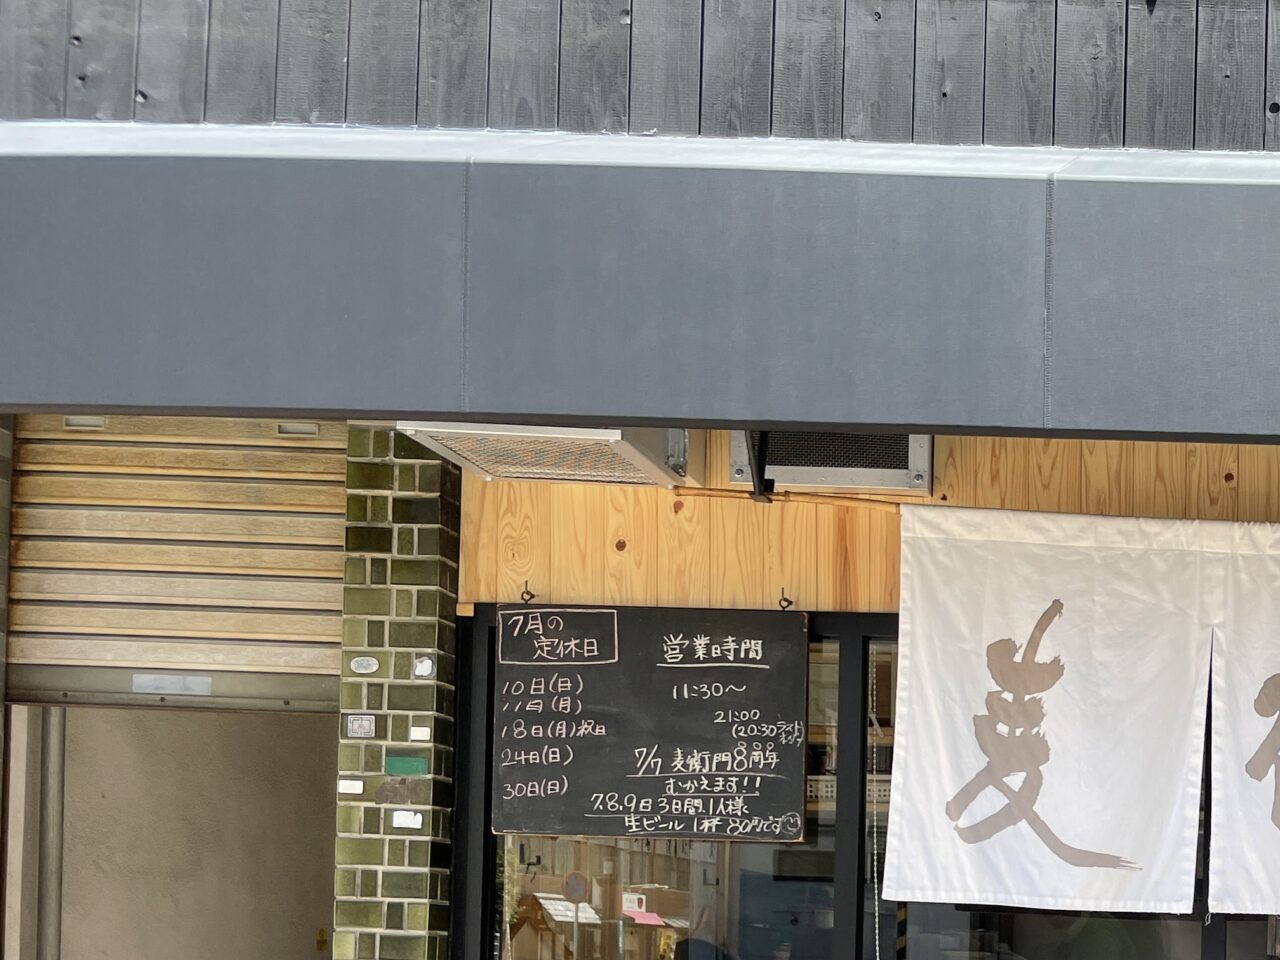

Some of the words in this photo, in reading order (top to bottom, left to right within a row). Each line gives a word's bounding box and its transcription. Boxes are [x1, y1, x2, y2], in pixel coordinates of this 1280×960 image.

[508, 612, 564, 637] 7月の
[532, 635, 600, 660] 定休日
[663, 633, 763, 663] 営業時間
[502, 672, 584, 695] 10日(日)
[713, 708, 760, 723] 21:00
[501, 744, 574, 767] 24日(日)
[634, 743, 662, 776] 7/7
[502, 775, 569, 800] 30日(日)
[624, 813, 685, 832] 生ビール
